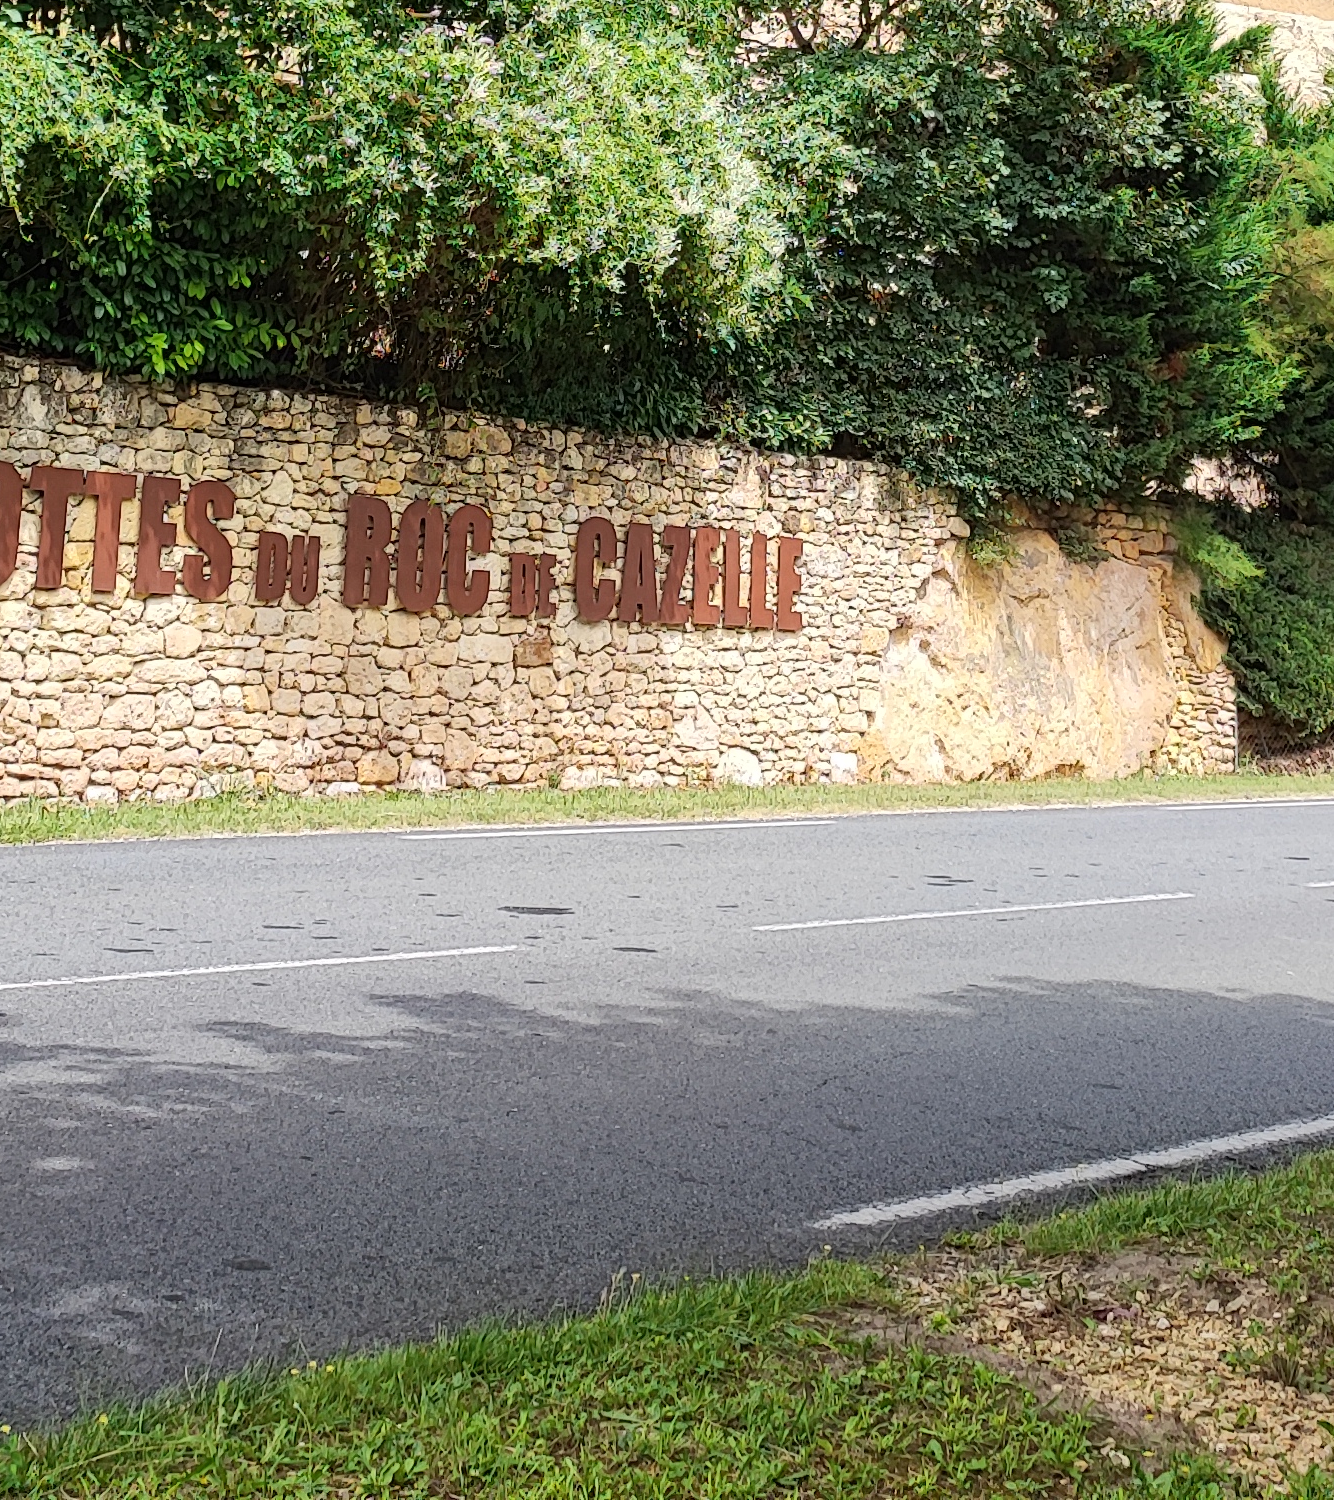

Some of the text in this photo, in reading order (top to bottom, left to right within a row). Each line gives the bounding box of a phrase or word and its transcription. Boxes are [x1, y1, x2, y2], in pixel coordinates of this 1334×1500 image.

[255, 531, 320, 604] DU
[343, 496, 493, 616] ROC
[510, 553, 557, 617] DE
[575, 517, 803, 631] CAZELLE
